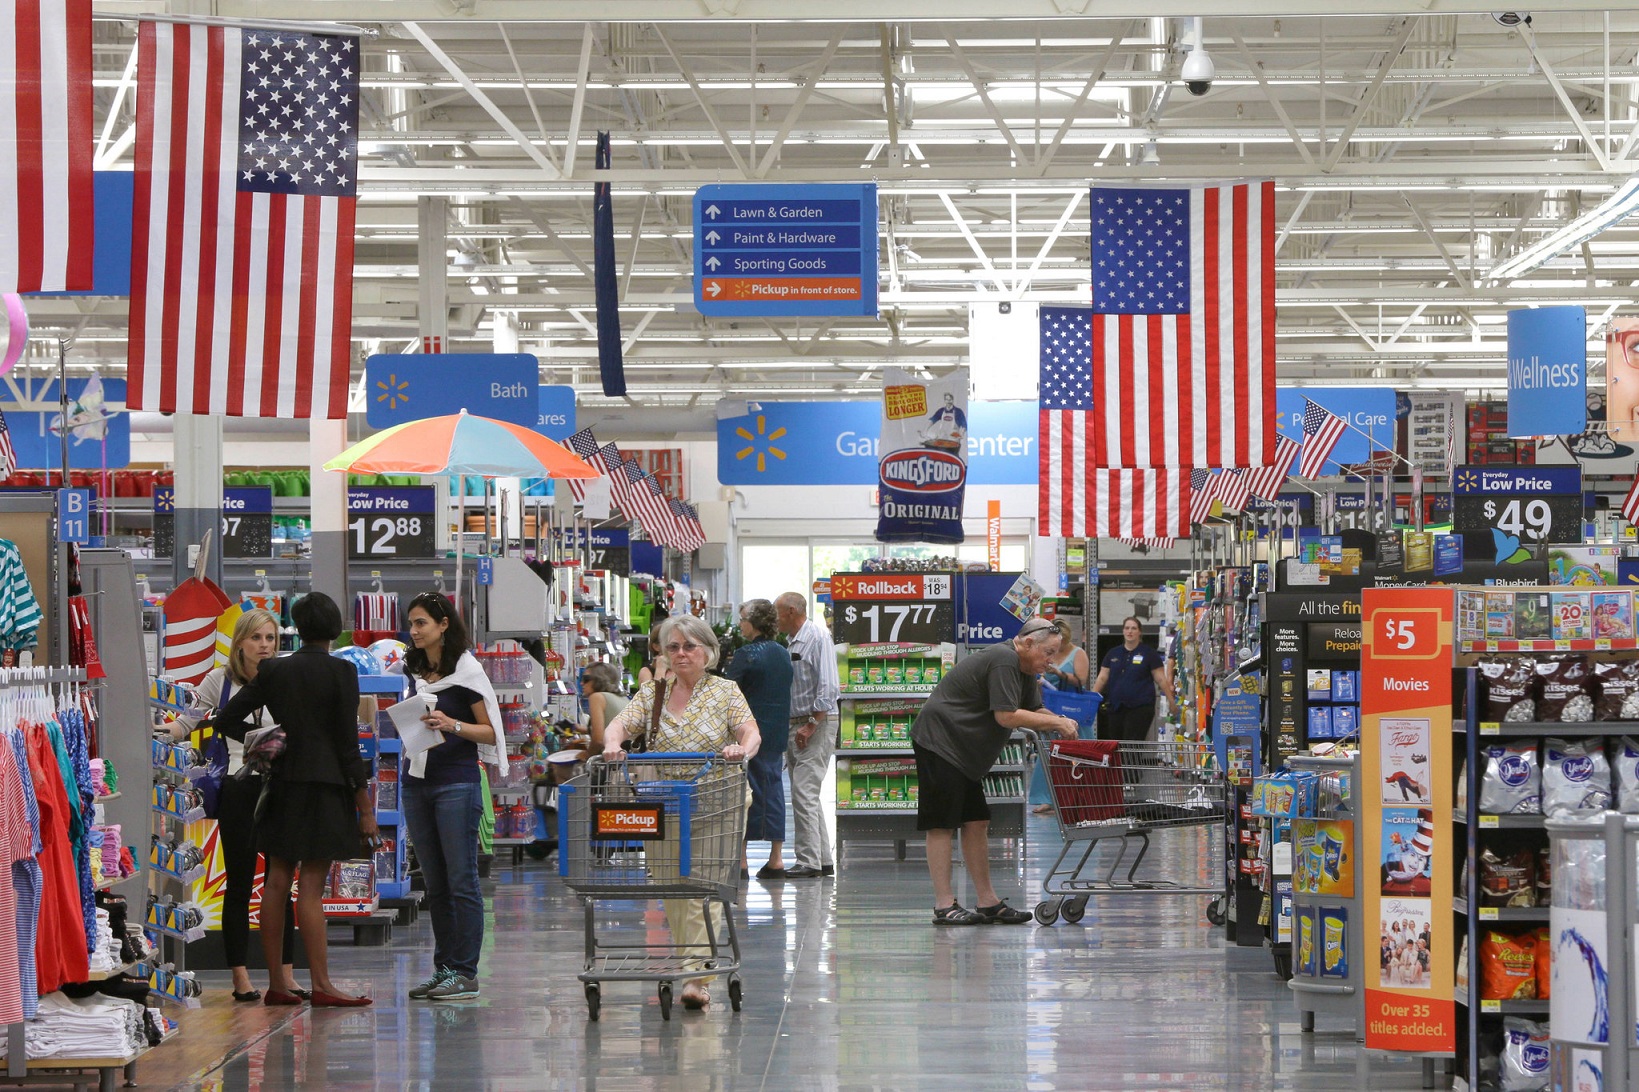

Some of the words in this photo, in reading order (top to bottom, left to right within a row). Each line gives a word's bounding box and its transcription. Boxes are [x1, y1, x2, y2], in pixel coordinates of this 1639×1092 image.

[734, 207, 764, 218] Lawn
[768, 207, 776, 218] &
[780, 206, 823, 218] Garden
[734, 232, 764, 244] Paint
[767, 232, 776, 244] &
[778, 232, 836, 244] Hardware
[734, 258, 784, 272] Sporting
[788, 258, 826, 270] Goods
[752, 284, 788, 296] Pickup
[800, 286, 821, 294] front
[824, 286, 832, 294] of
[834, 286, 858, 294] store.
[1512, 356, 1579, 389] Wellness
[490, 382, 528, 398] Bath
[889, 402, 924, 416] LONGER
[537, 414, 566, 425] ares
[1355, 411, 1386, 426] Care
[836, 432, 880, 456] Gar
[966, 434, 1033, 456] enter
[886, 456, 960, 485] KINGSFORD
[1482, 478, 1512, 490] Low
[1516, 478, 1552, 490] Price
[68, 492, 82, 512] B
[223, 497, 244, 508] rice
[376, 498, 408, 508] Price
[884, 502, 958, 520] ORIGINAL
[66, 520, 82, 537] 11
[481, 559, 490, 570] H
[482, 572, 488, 582] 3
[858, 582, 916, 594] Rollback
[1299, 602, 1314, 614] All
[1318, 602, 1339, 614] the
[1342, 602, 1360, 614] fin
[1561, 606, 1581, 620] 20
[958, 623, 1002, 638] Price
[1335, 628, 1361, 638] Reloa
[1386, 618, 1416, 650] $5
[1384, 678, 1429, 690] Movies
[1388, 732, 1420, 748] Fargo
[616, 813, 656, 827] Pickup
[1381, 1003, 1410, 1016] Over
[1412, 1005, 1430, 1018] 35
[1370, 1020, 1398, 1034] titles
[1401, 1022, 1446, 1036] added.
